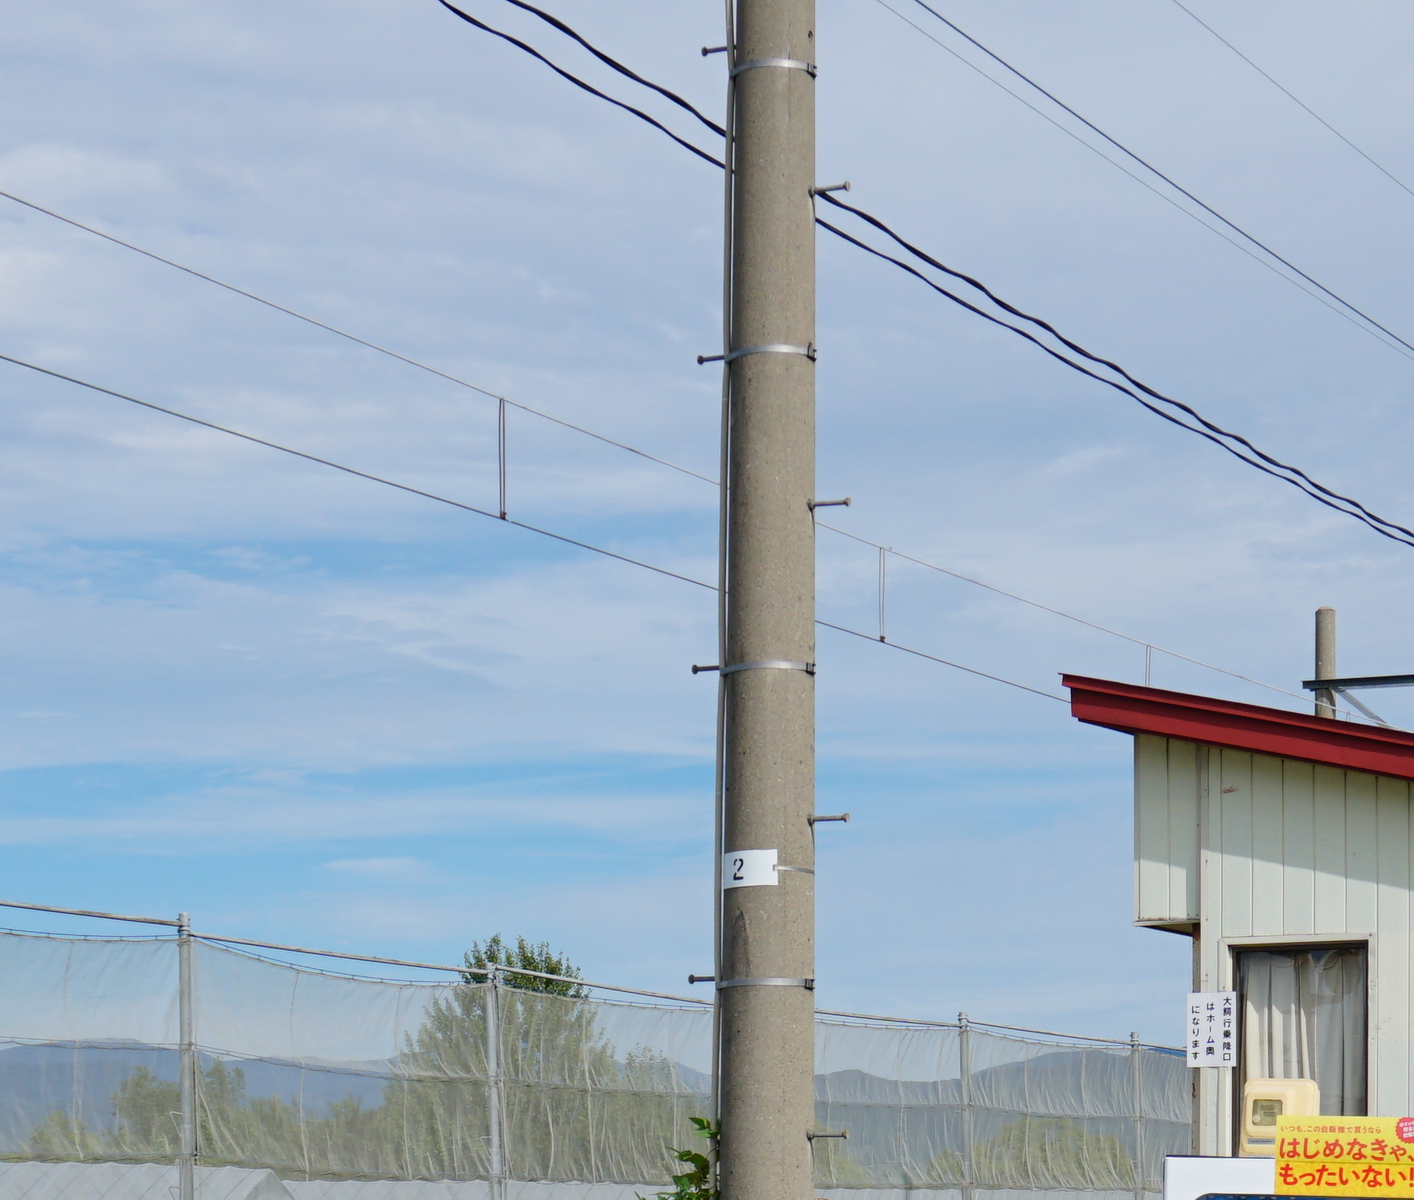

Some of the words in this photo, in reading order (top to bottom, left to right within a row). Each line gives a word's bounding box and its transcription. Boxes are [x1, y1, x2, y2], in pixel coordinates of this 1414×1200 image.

[733, 858, 744, 880] 2
[1192, 1005, 1200, 1060] になります
[1206, 1002, 1215, 1055] はホーム奥
[1278, 1163, 1414, 1188] もったいない!
